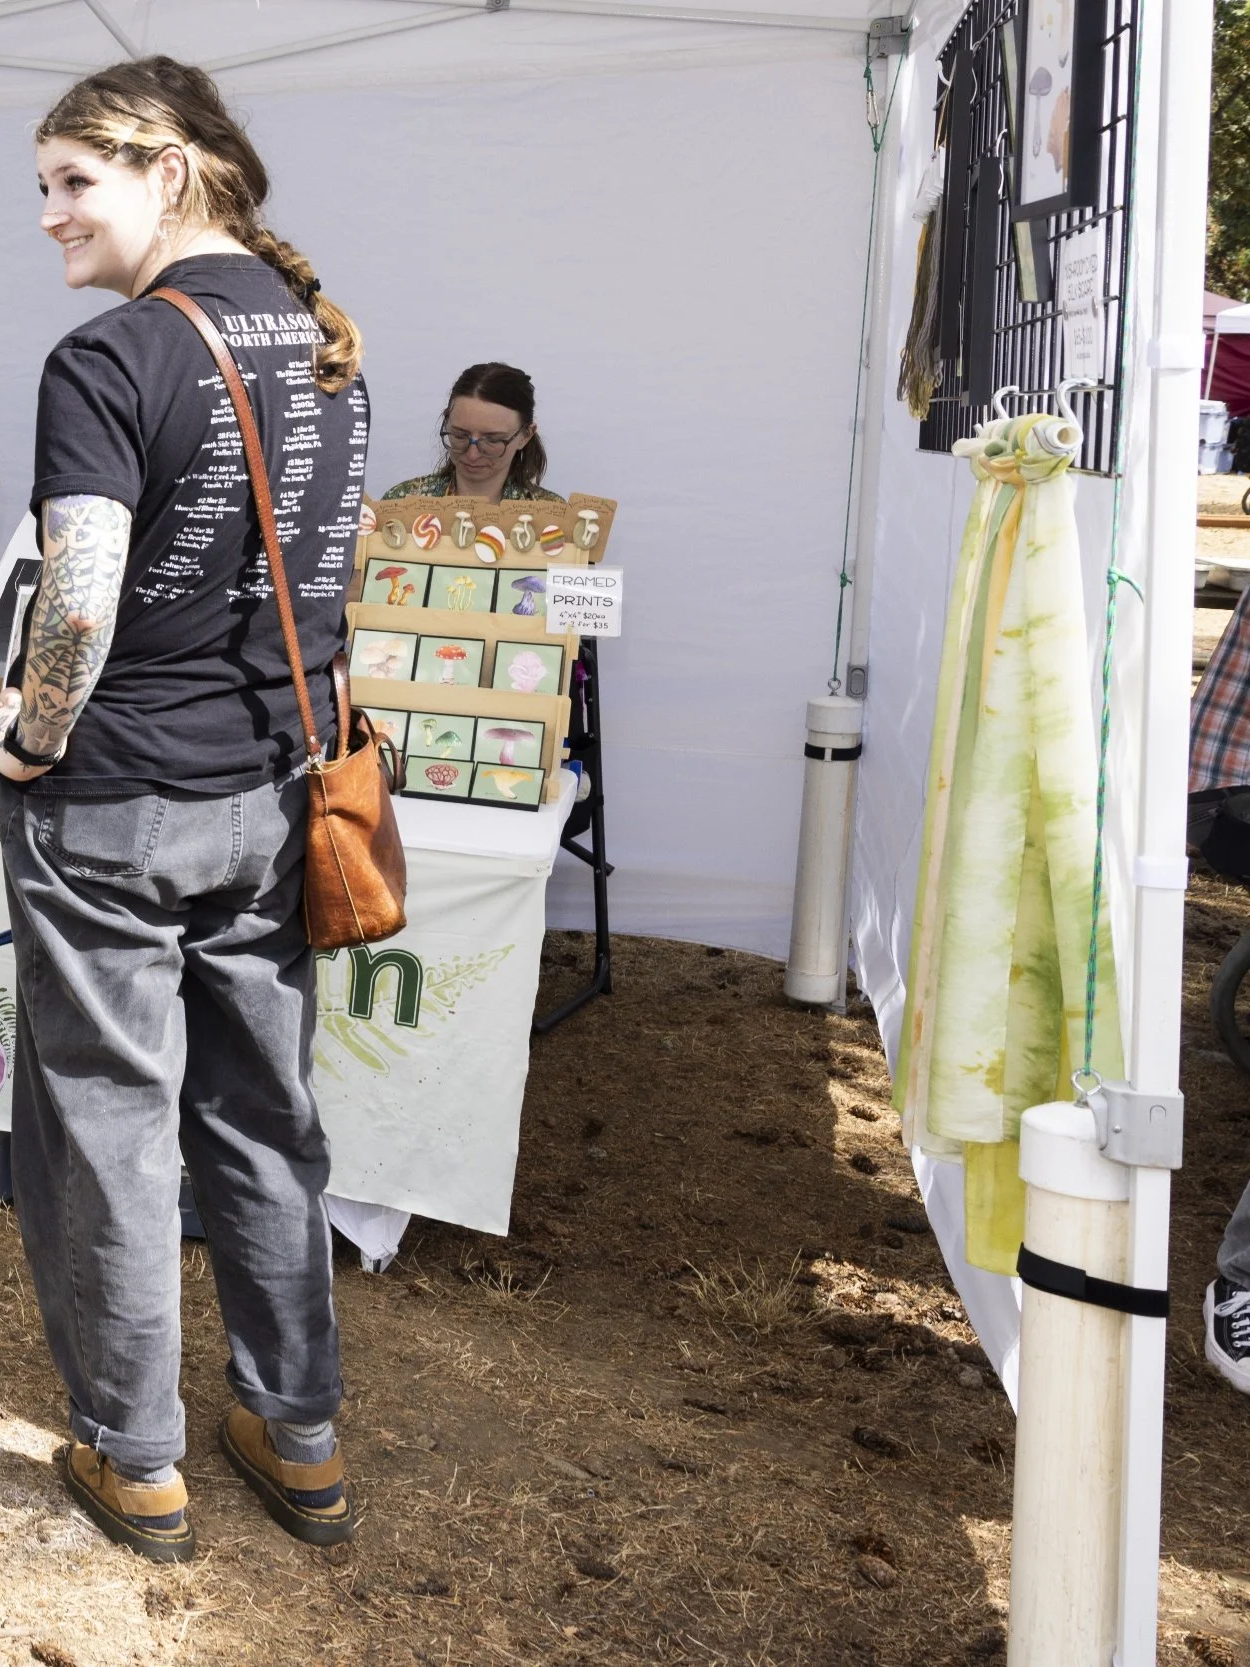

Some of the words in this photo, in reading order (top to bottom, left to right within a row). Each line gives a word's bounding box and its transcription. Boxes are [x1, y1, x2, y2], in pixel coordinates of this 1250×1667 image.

[222, 313, 320, 333] ULTRASOU
[552, 575, 617, 588] FRAMED
[553, 594, 614, 607] PRINTS
[593, 621, 609, 629] $35
